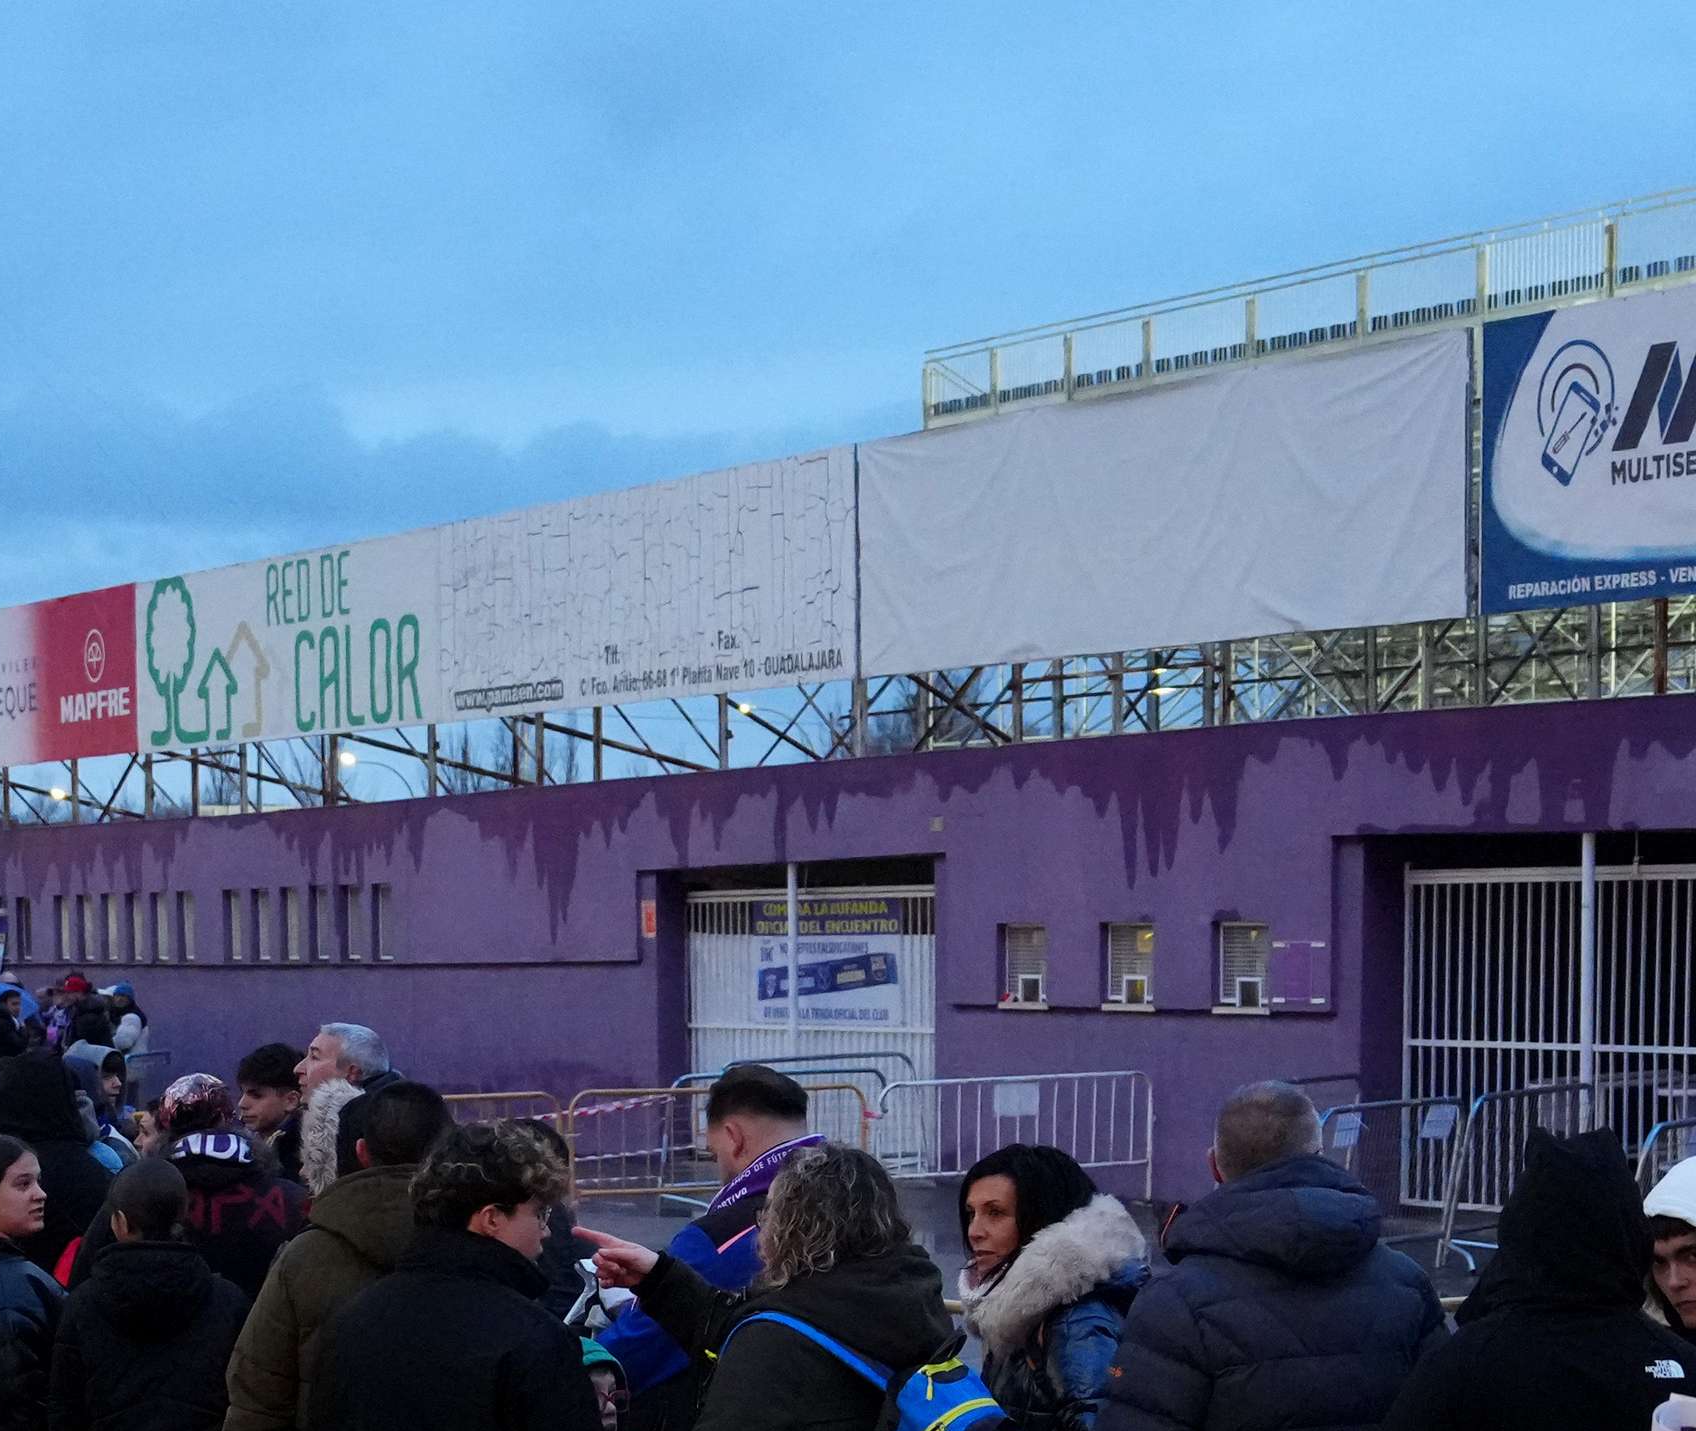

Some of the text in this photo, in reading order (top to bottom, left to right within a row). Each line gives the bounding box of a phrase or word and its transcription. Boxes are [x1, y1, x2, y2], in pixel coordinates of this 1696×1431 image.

[266, 550, 351, 627] RED DE
[1509, 574, 1591, 599] REPARACIÓN
[1595, 570, 1657, 591] EXPRESS
[294, 614, 423, 733] CALOR
[716, 663, 740, 681] Nave
[764, 648, 843, 677] GUADALAJARA
[60, 687, 131, 724] MAPFRE
